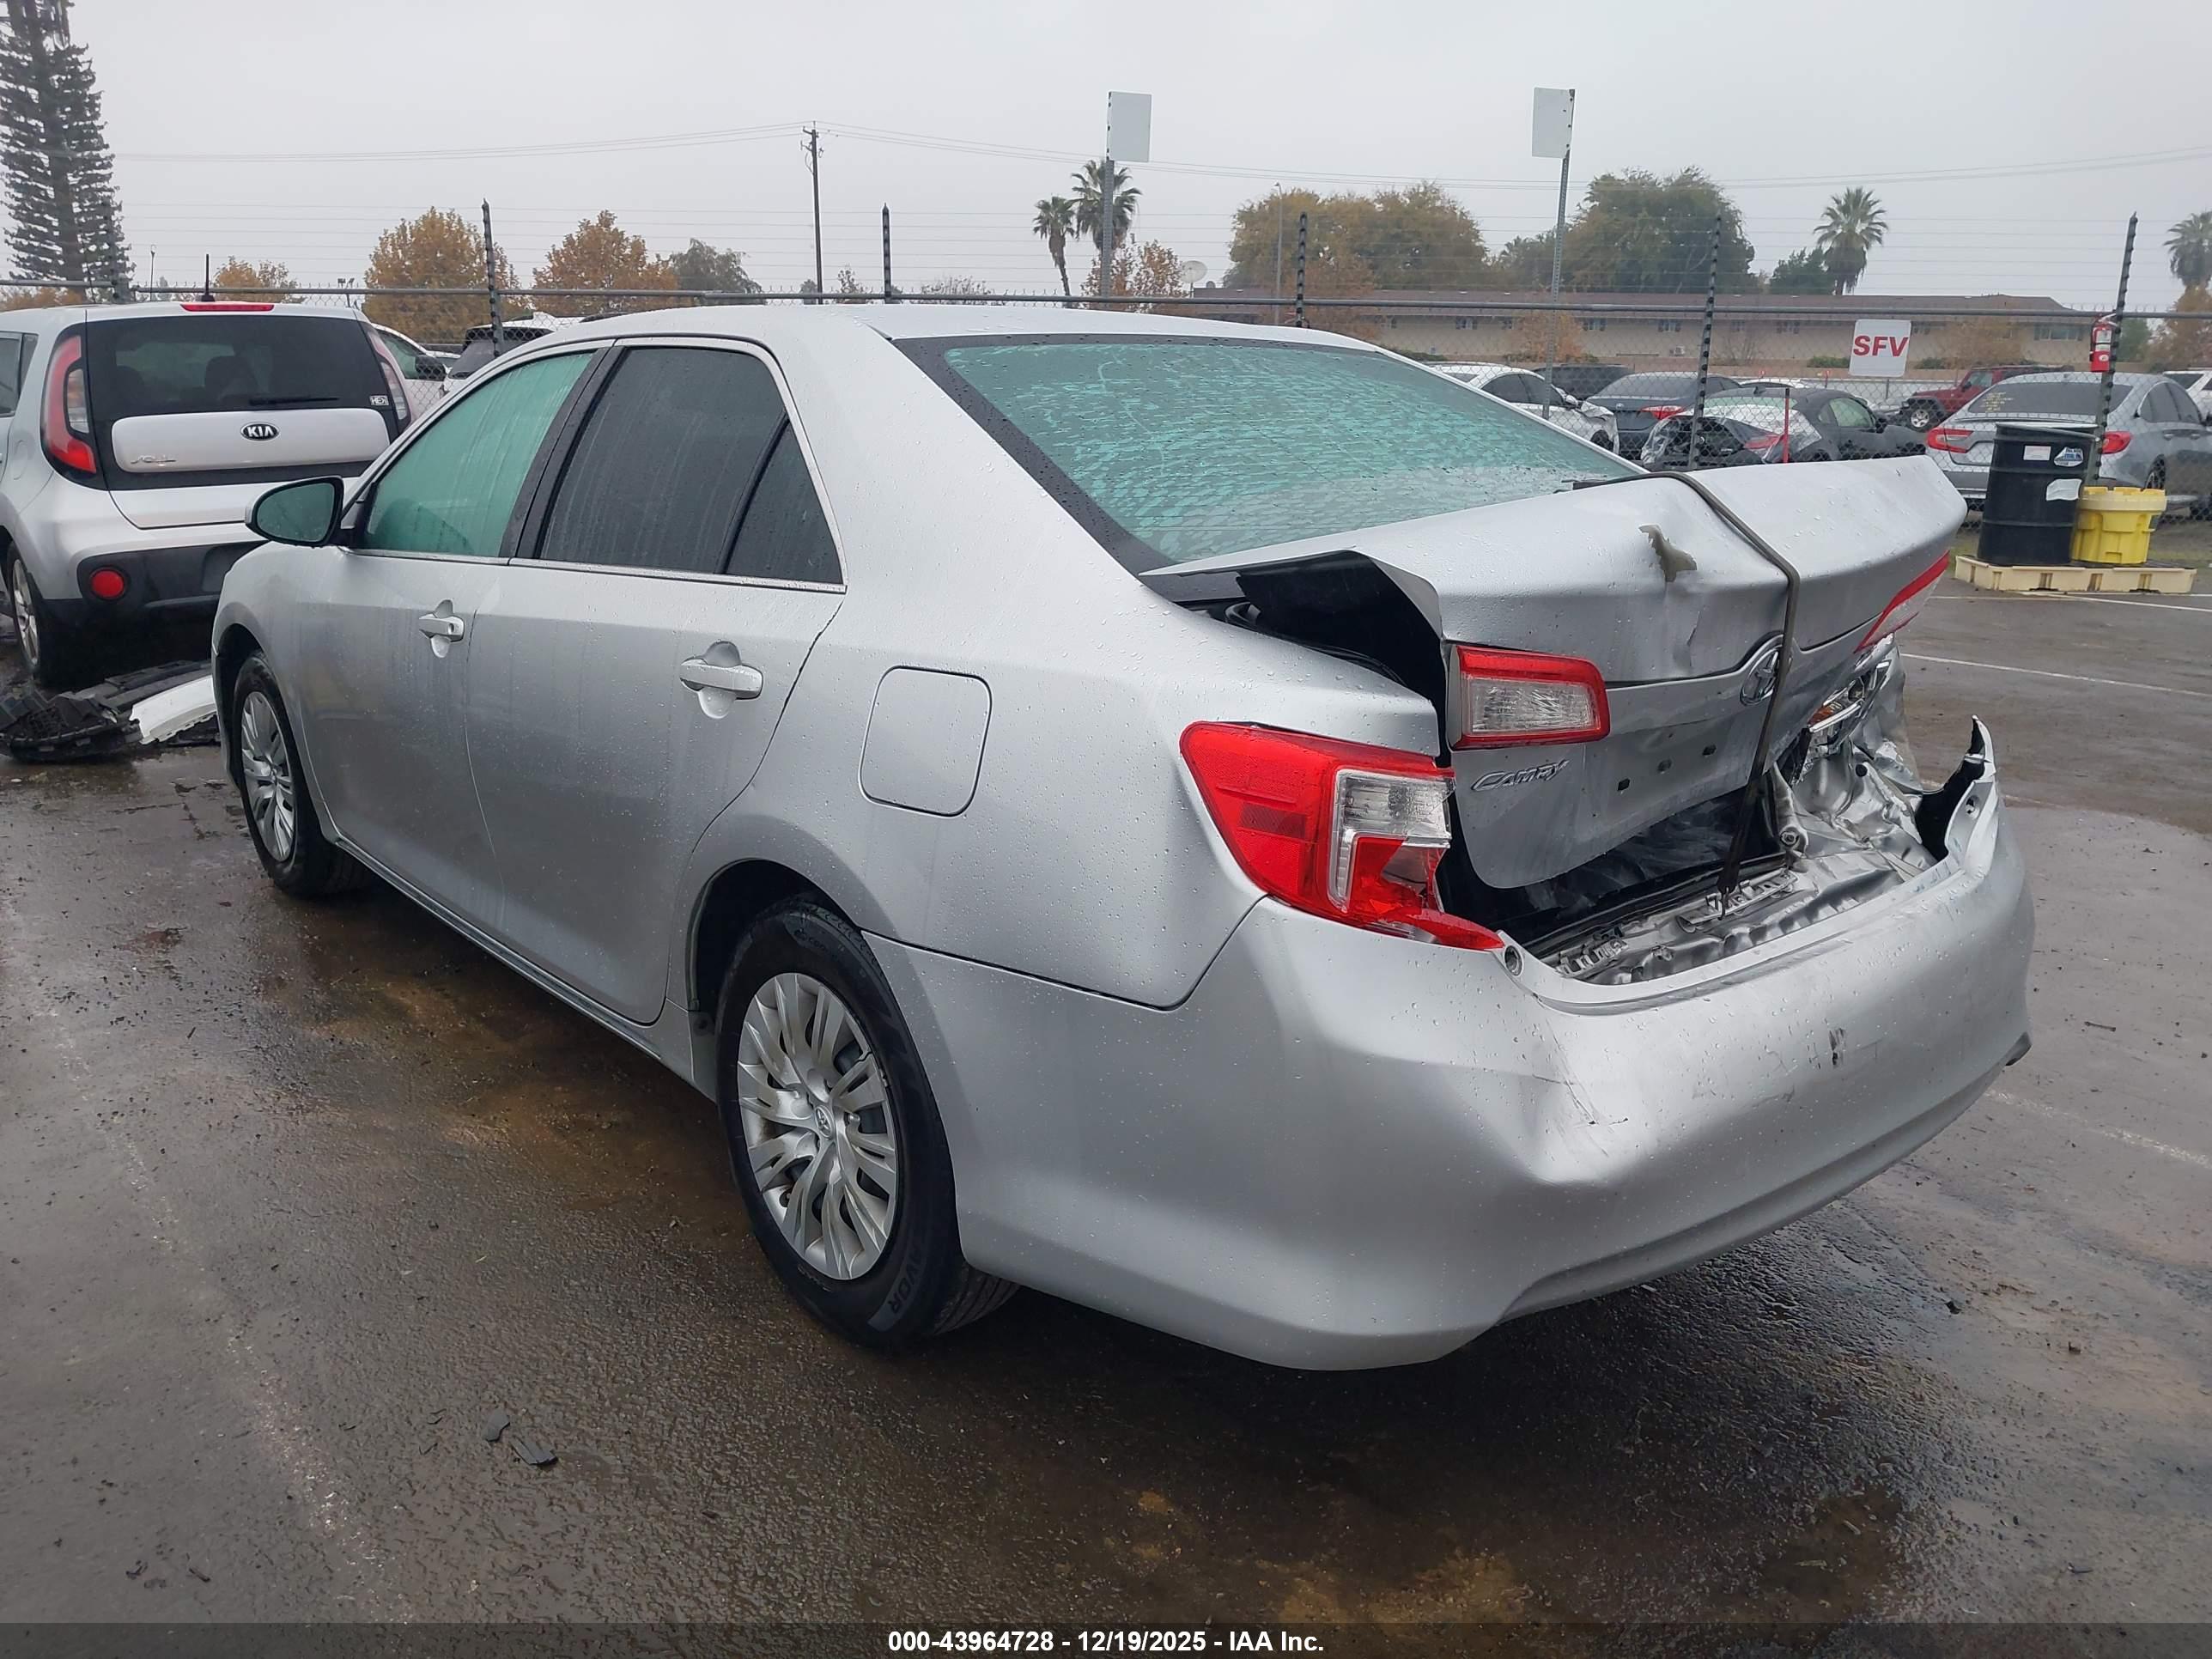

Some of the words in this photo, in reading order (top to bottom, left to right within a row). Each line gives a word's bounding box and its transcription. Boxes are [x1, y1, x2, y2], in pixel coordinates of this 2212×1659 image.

[1853, 335, 1909, 357] SFV
[246, 425, 275, 438] KIA
[1470, 758, 1570, 792] CAMRY
